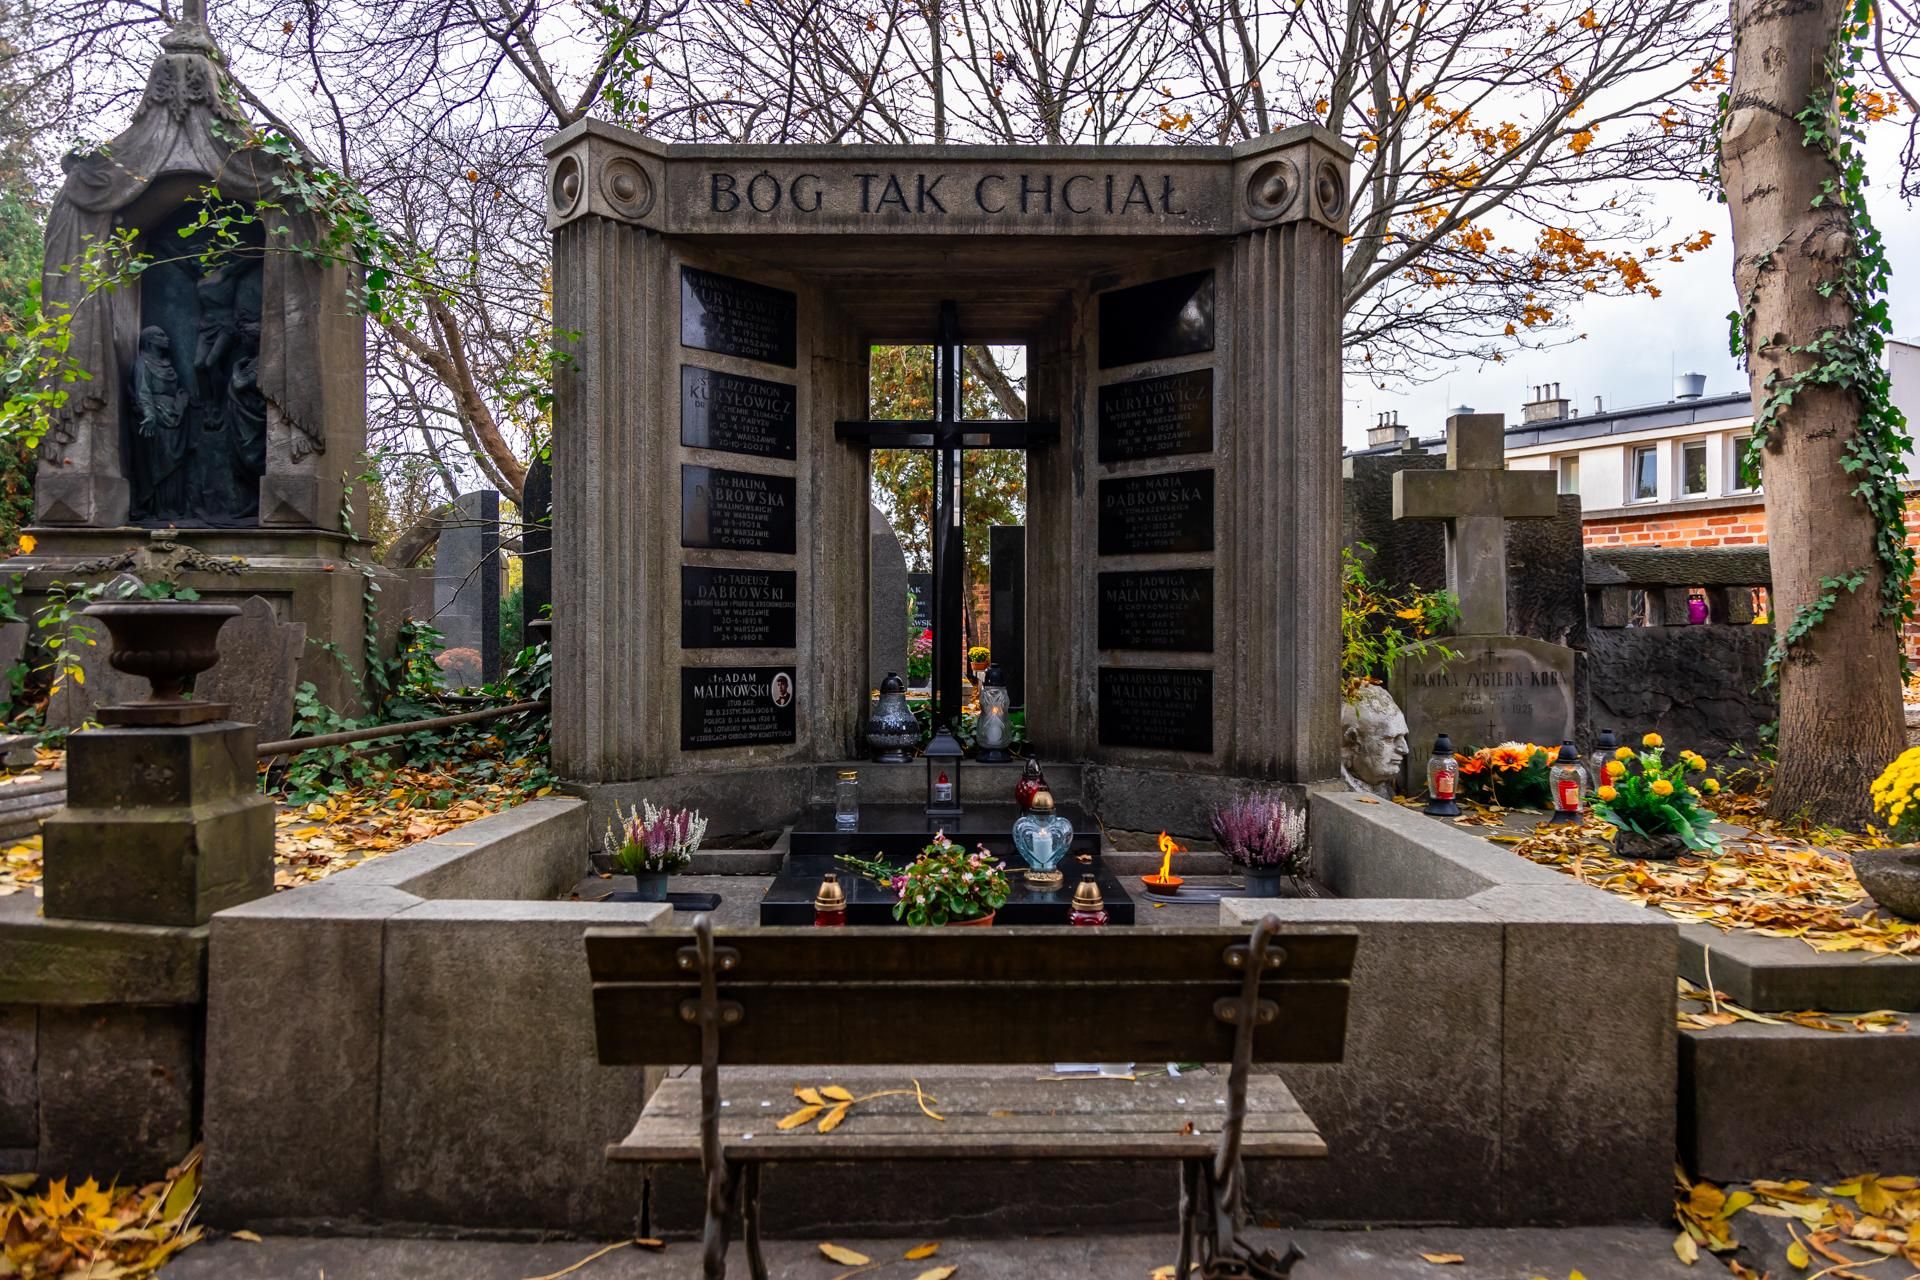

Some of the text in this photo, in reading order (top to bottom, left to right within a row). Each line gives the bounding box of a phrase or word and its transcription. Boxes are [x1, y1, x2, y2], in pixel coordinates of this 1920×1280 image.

[710, 169, 1187, 215] BÓG TAK CHCIAŁ
[732, 477, 767, 491] HALINA
[729, 575, 769, 585] TADEUSZ
[1106, 588, 1201, 602] MALINOWSKA
[725, 673, 756, 683] ADAM
[694, 684, 769, 699] MALINOWSKI
